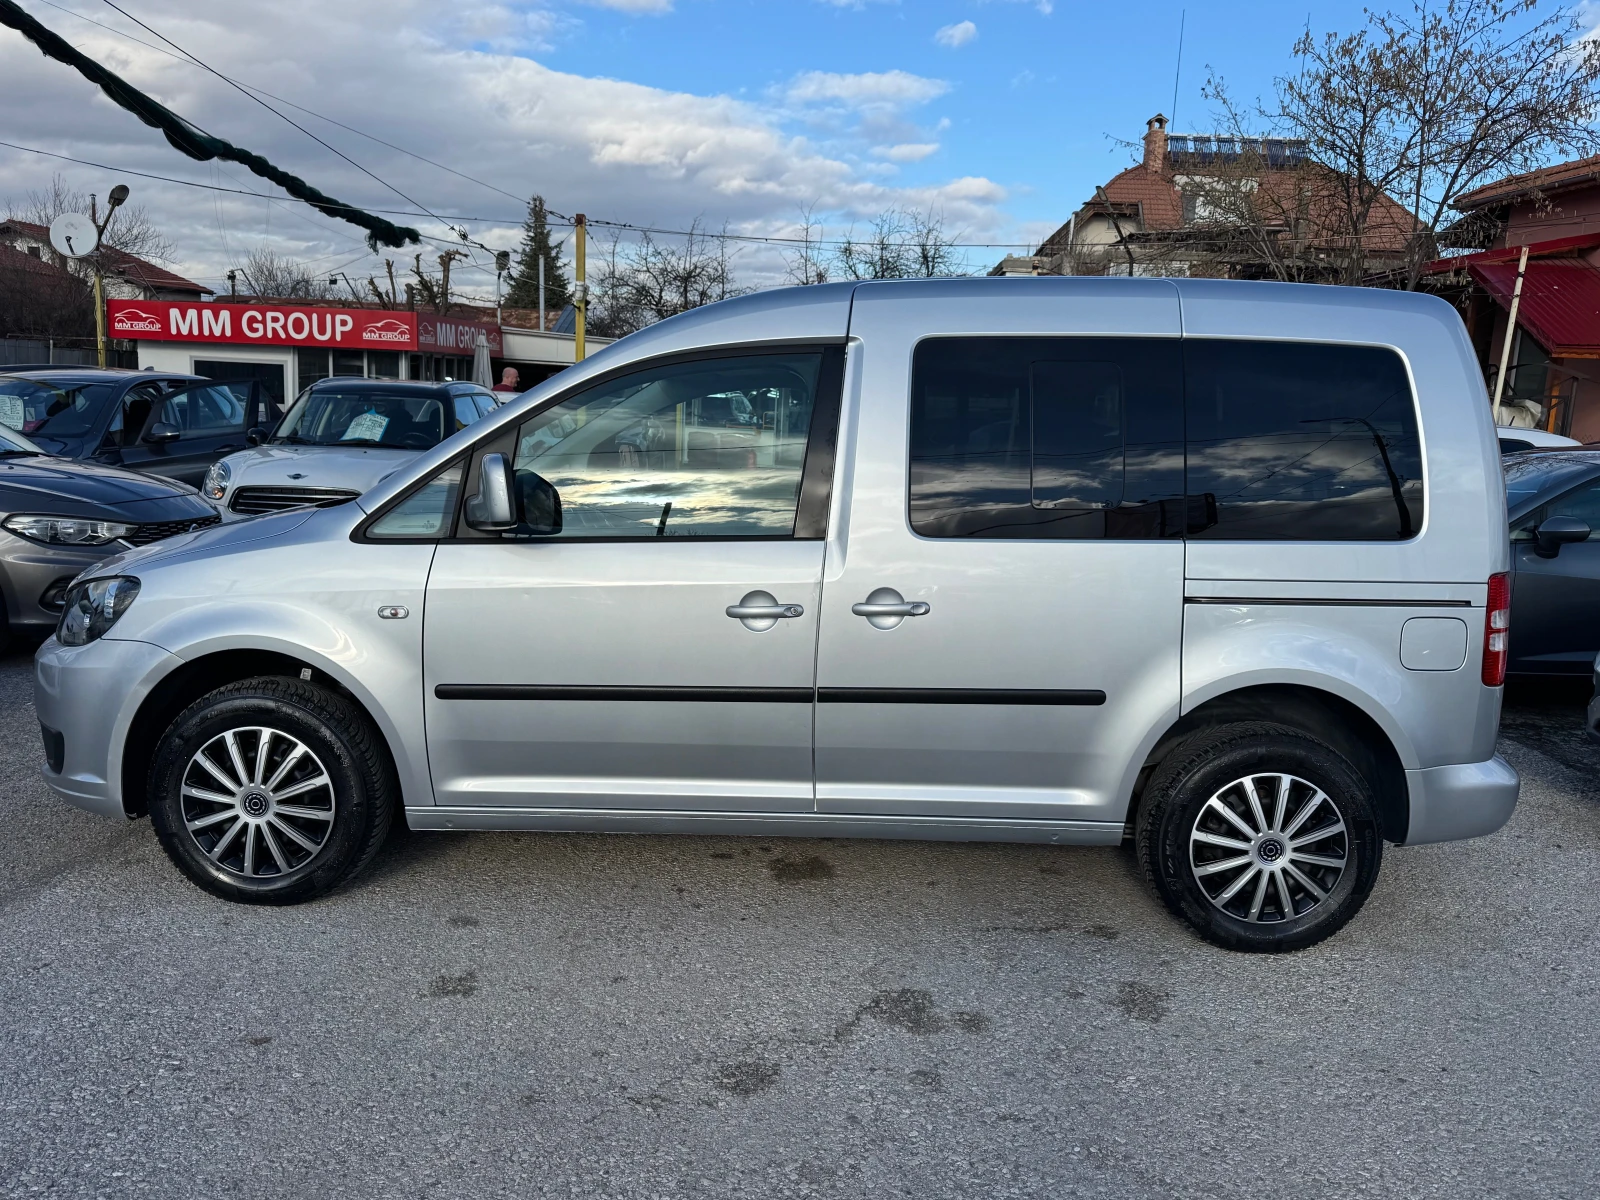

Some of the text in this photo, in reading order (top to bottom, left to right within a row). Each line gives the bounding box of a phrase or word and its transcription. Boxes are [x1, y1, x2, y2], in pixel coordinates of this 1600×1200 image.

[169, 307, 353, 342] MM GROUP
[380, 333, 411, 341] GROUP
[436, 322, 456, 348] MM
